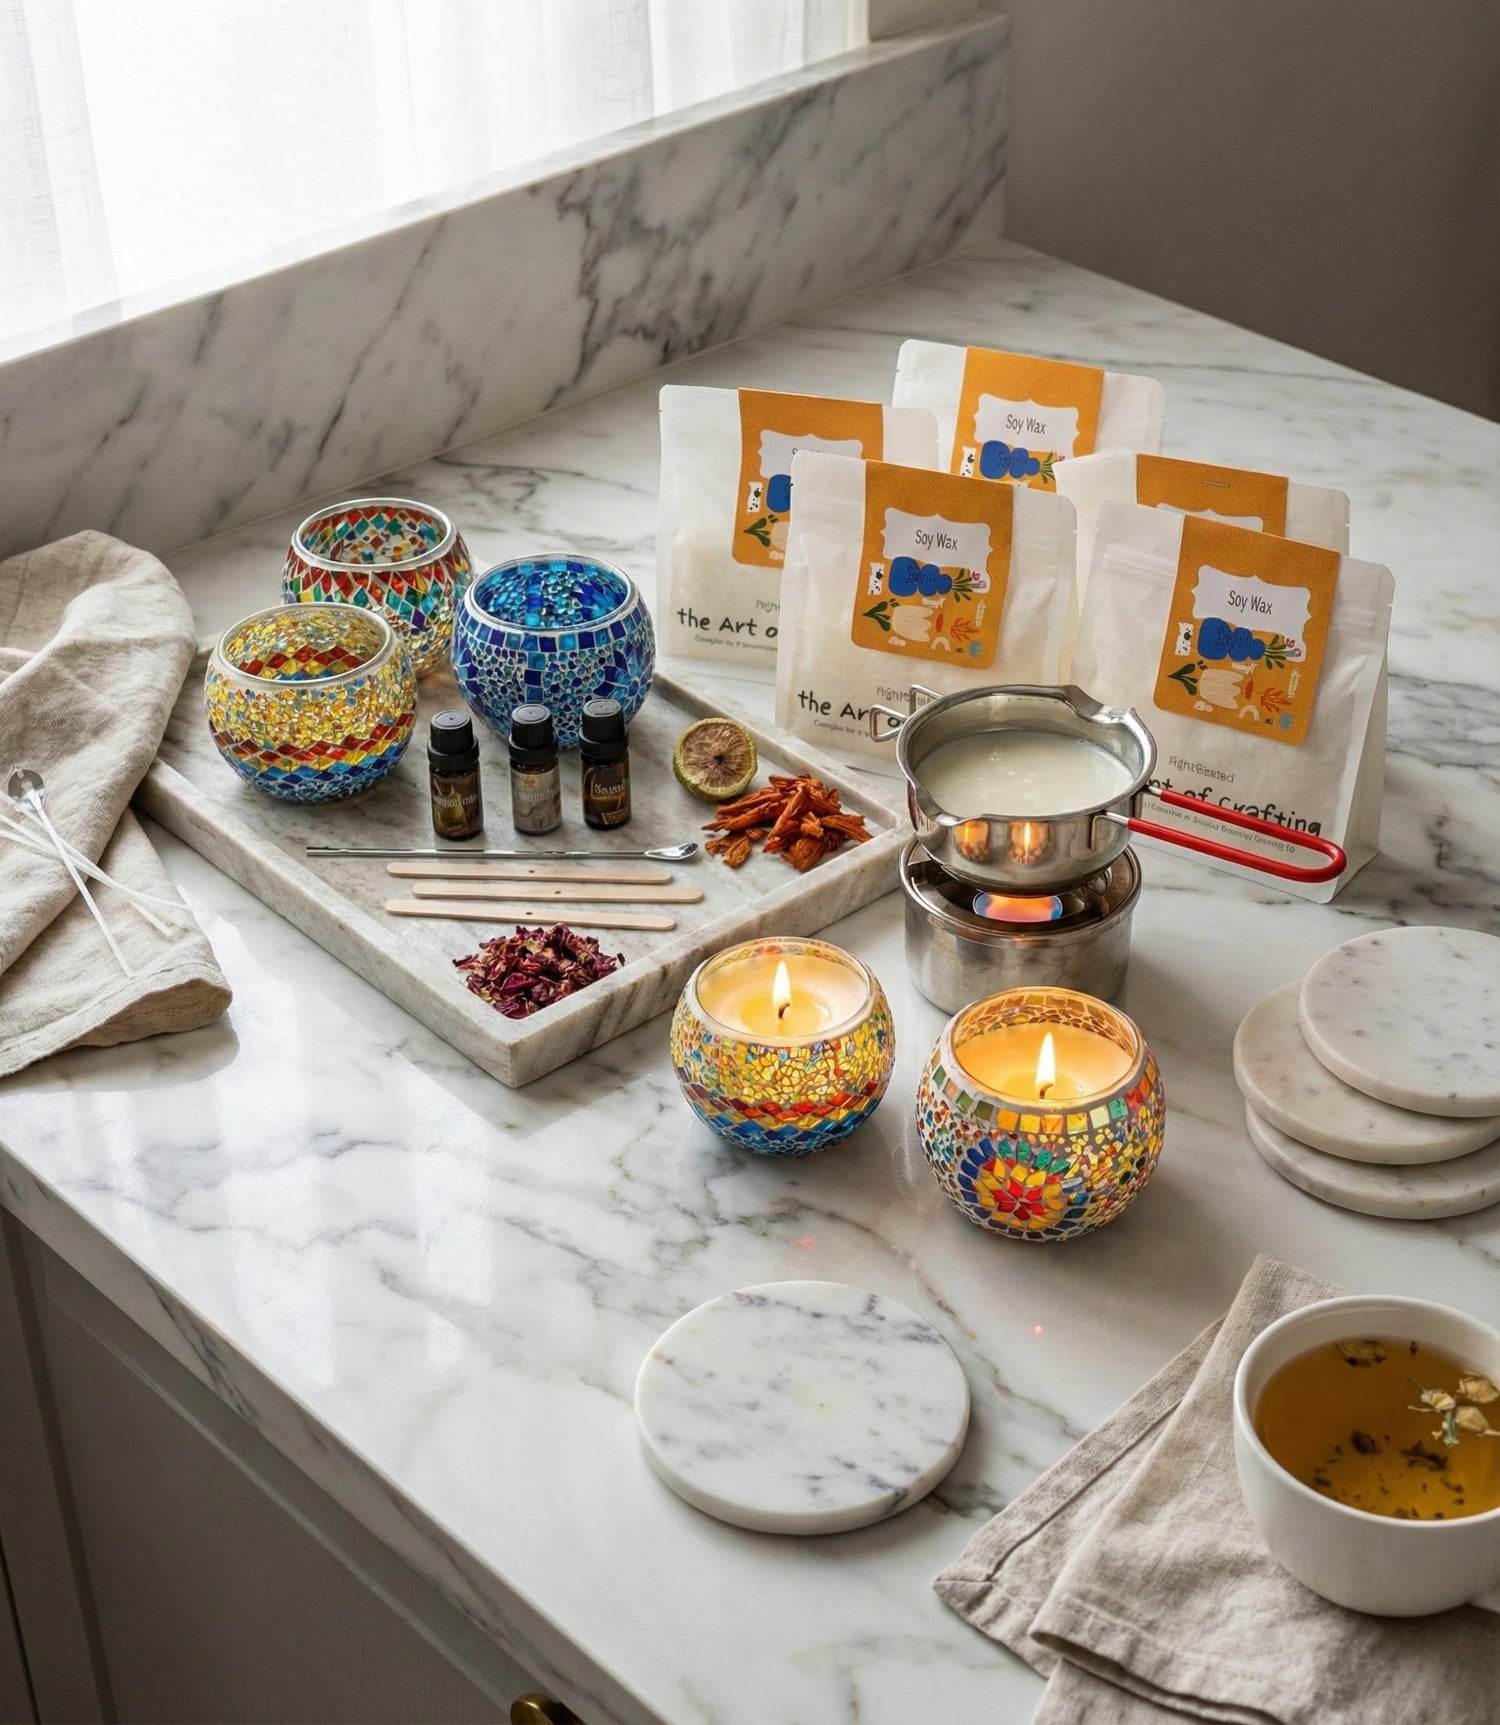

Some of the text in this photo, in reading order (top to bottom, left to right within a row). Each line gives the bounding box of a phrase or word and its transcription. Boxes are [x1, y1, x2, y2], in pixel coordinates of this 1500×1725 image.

[1005, 414, 1046, 435] Soy Wax
[915, 529, 958, 551] Soy Wax
[1227, 590, 1273, 615] Soy Wax
[677, 607, 778, 638] the Art o
[798, 690, 832, 716] the
[840, 702, 870, 721] Ar
[1218, 796, 1322, 837] Crafting
